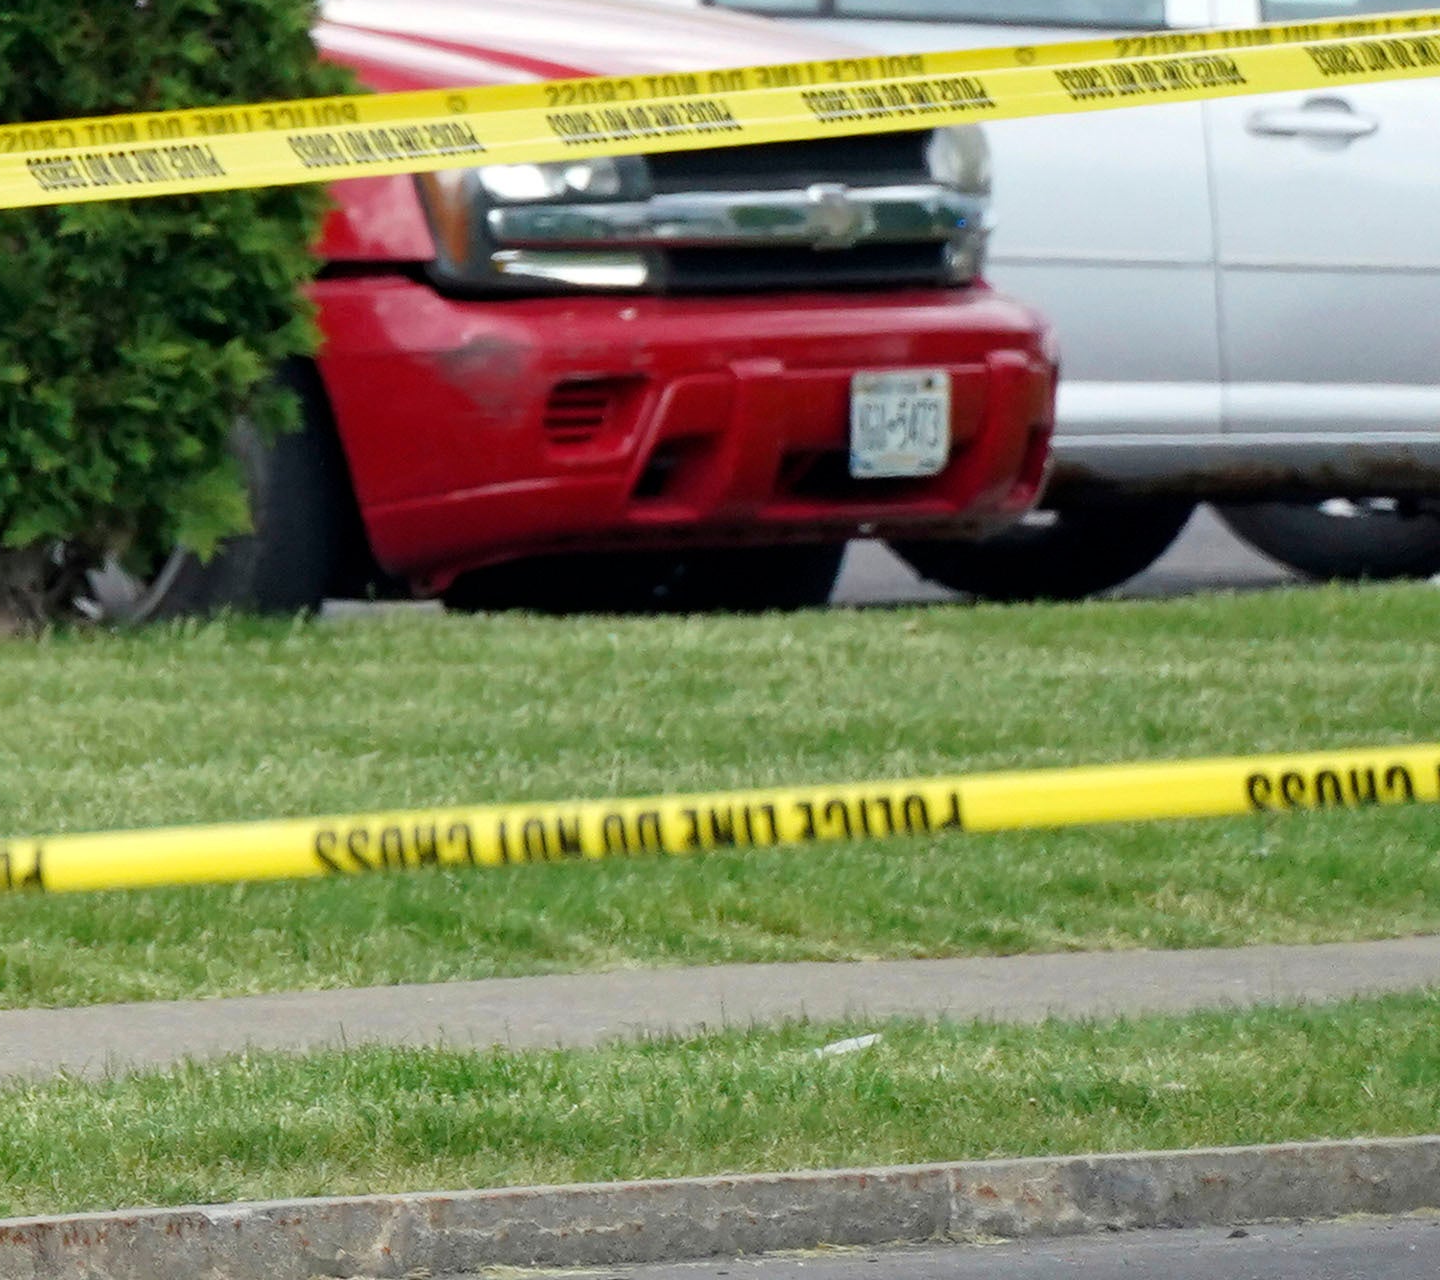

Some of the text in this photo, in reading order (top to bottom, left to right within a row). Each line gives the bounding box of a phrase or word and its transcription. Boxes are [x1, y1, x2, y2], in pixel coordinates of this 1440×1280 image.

[1245, 765, 1415, 813] CROSS
[315, 791, 964, 871] POLICE LINE DO NOT CROSS
